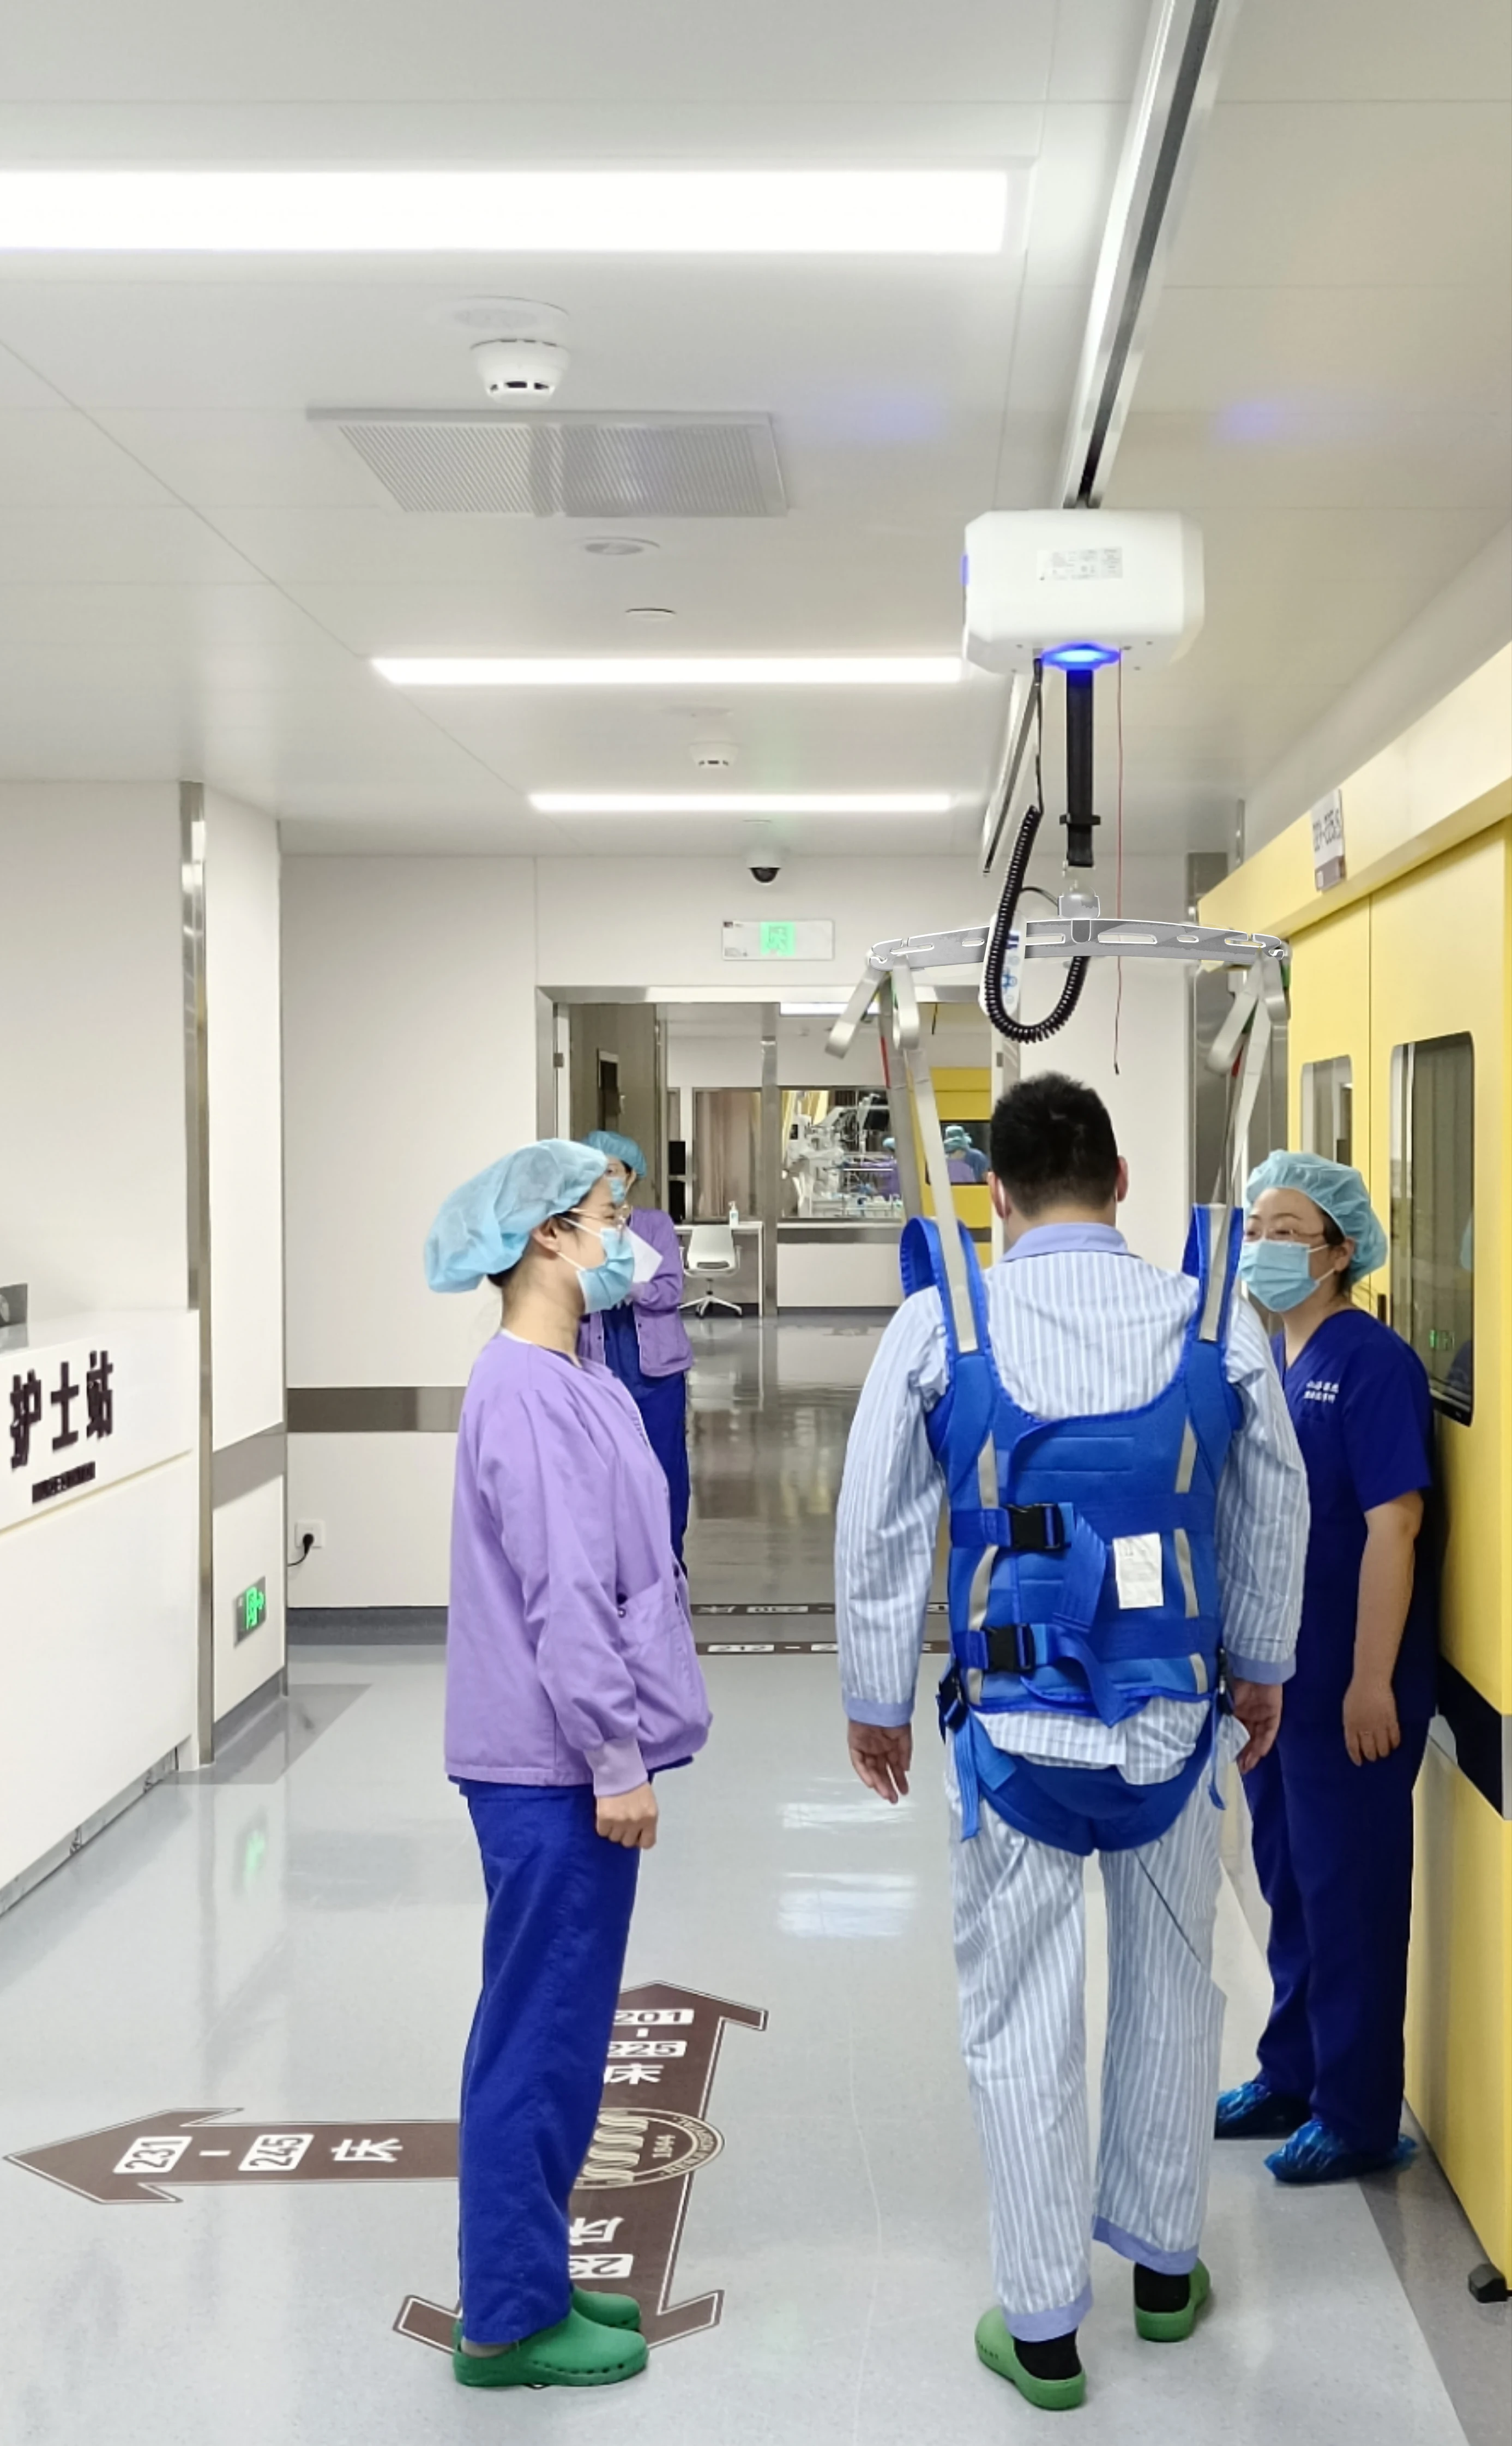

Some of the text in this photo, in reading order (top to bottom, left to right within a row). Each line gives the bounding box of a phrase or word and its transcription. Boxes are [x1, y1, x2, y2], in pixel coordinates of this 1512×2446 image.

[10, 1350, 113, 1470] 护士站
[615, 2011, 682, 2023] 201
[604, 2063, 664, 2084] 床
[124, 2141, 183, 2169] 231
[249, 2137, 304, 2166] 245
[330, 2137, 403, 2162] 床
